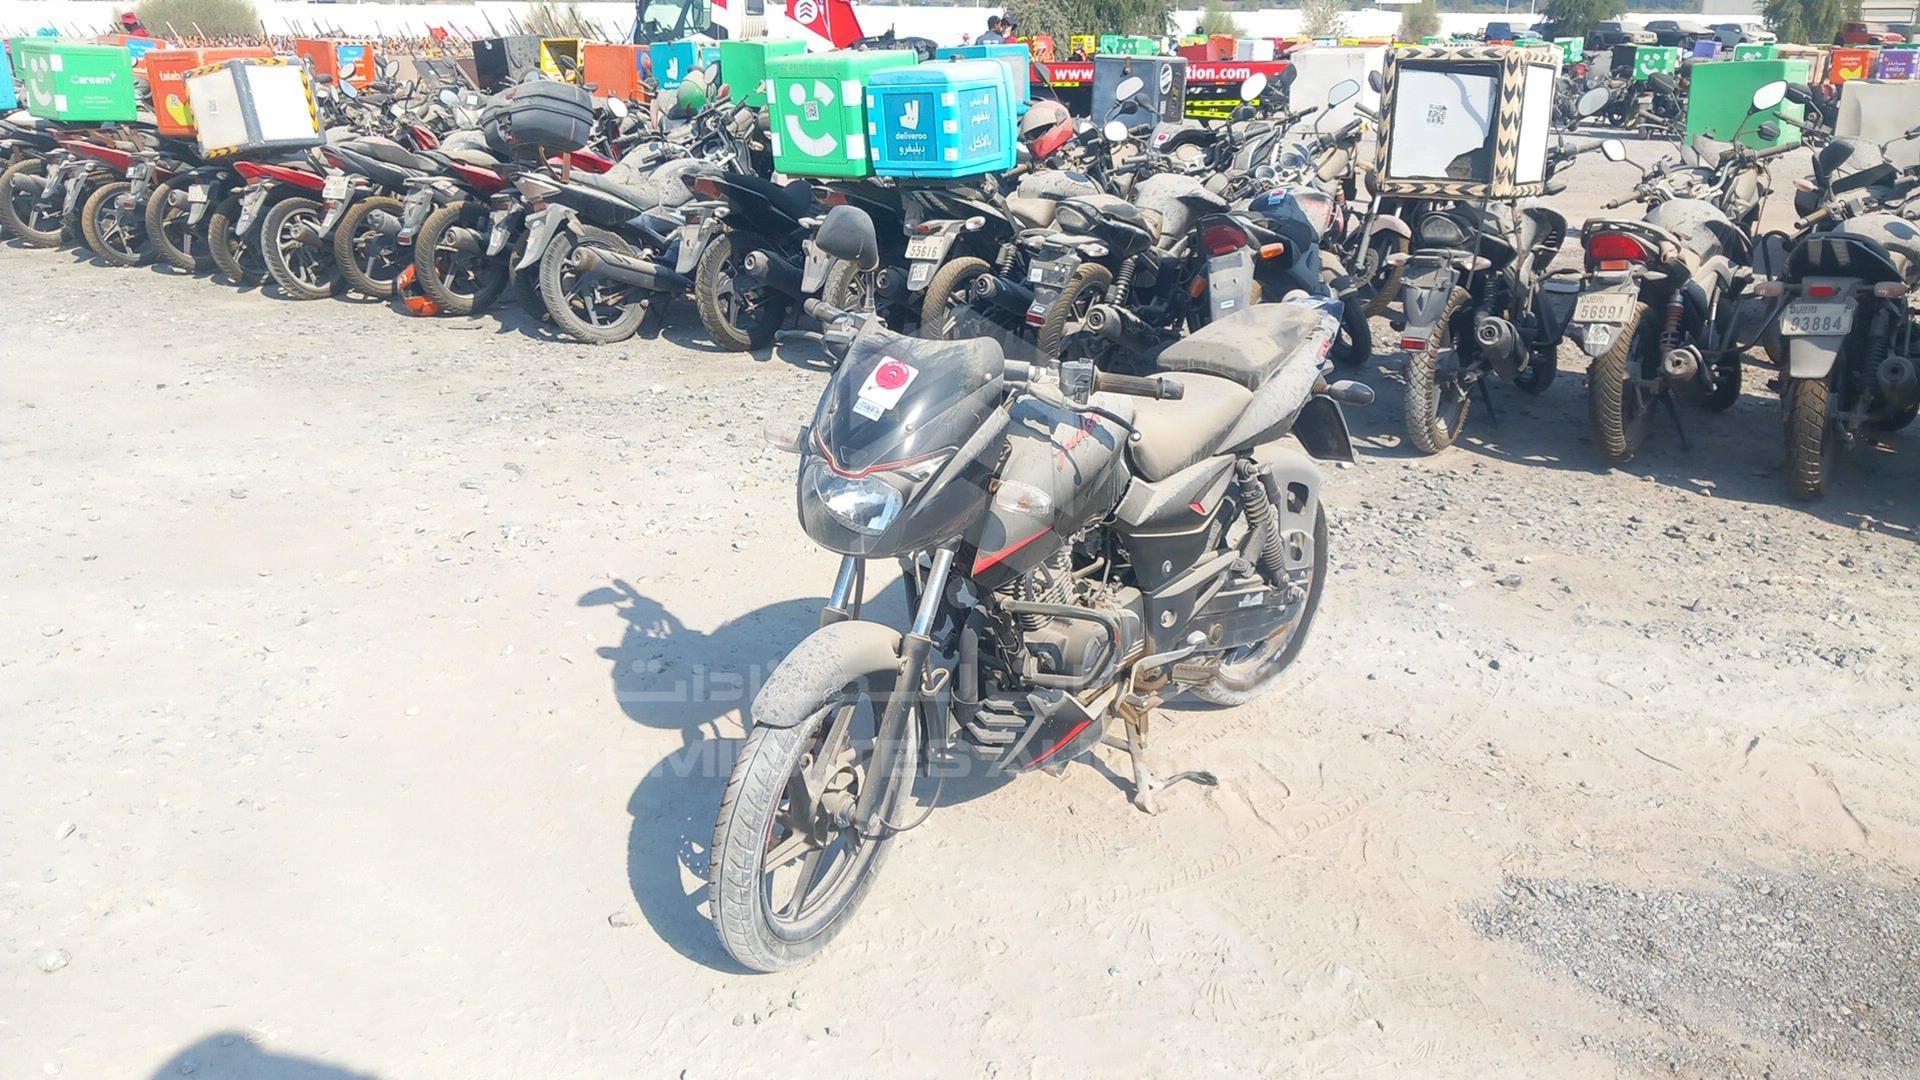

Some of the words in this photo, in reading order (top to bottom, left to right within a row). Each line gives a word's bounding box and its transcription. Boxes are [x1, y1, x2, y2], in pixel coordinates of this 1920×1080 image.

[896, 132, 928, 141] deliveroo
[910, 245, 938, 257] 55616
[1581, 305, 1624, 319] 56991
